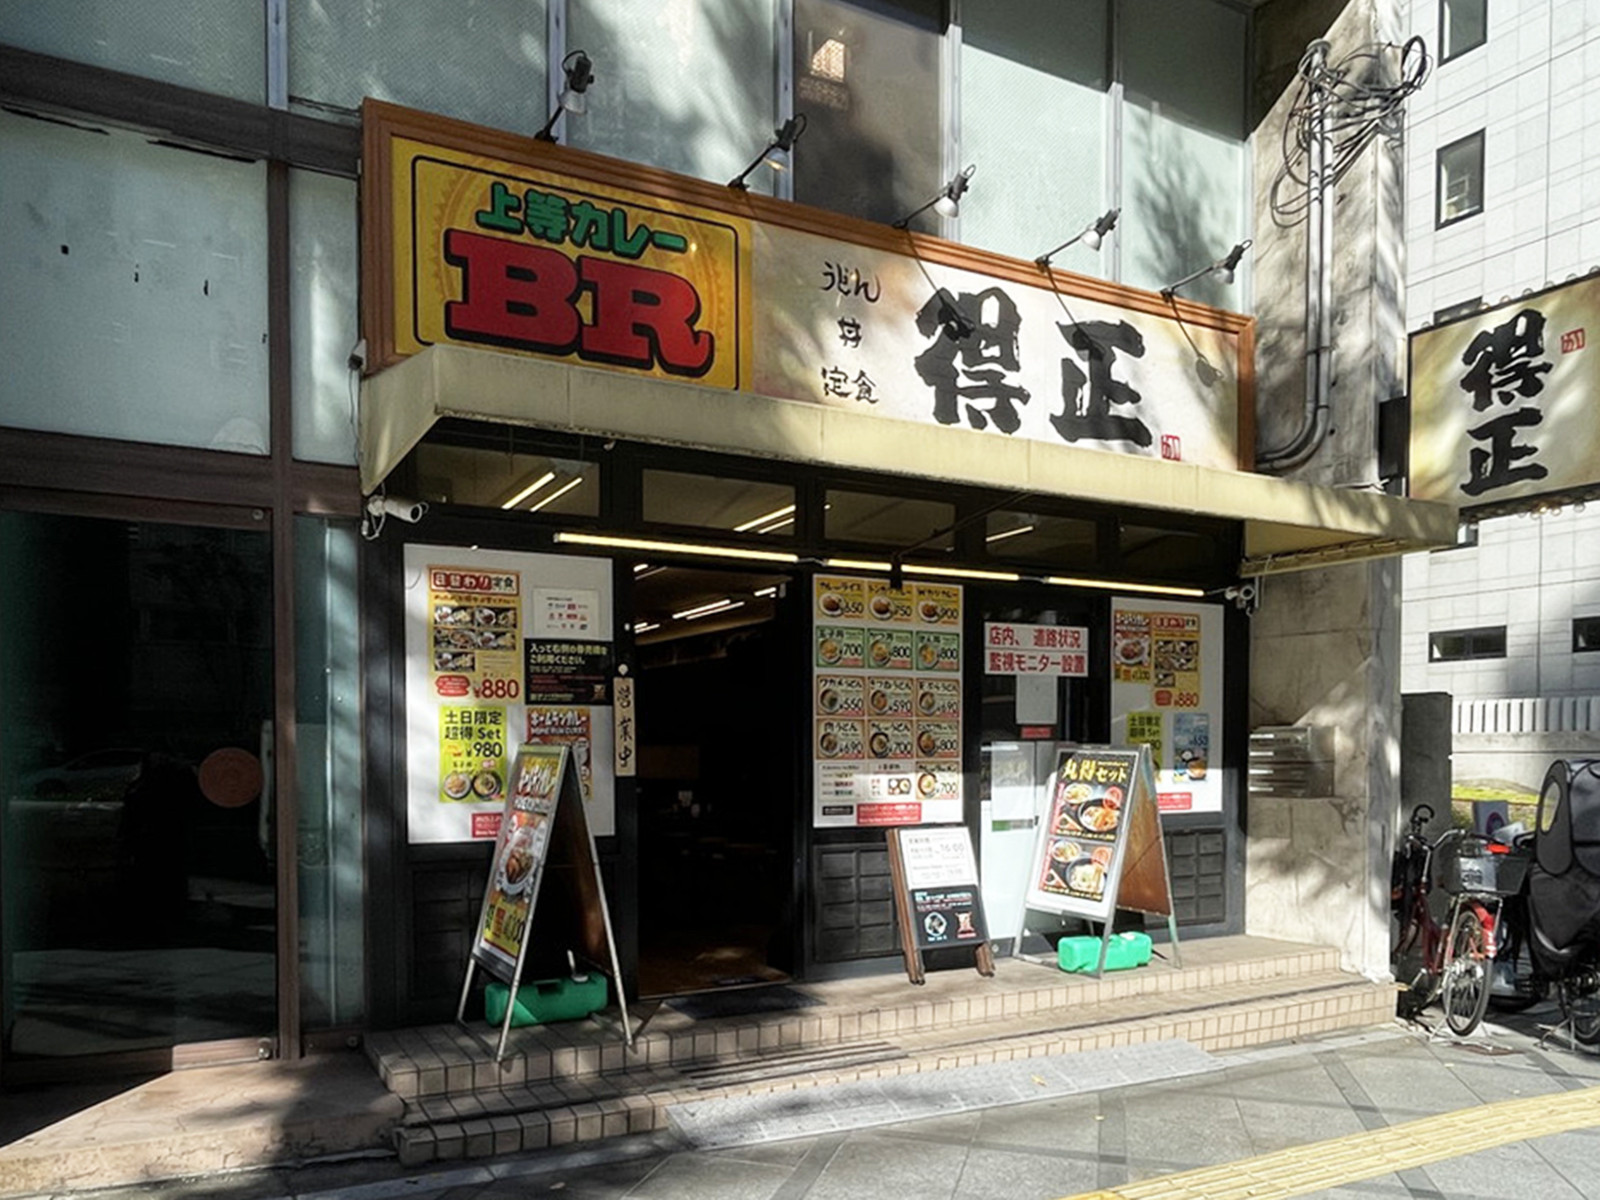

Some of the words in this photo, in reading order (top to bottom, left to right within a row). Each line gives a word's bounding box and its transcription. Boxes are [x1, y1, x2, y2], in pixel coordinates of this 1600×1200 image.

[475, 182, 688, 258] 上等カレー
[820, 262, 882, 303] うどん
[444, 227, 715, 378] BR
[837, 316, 863, 349] 丼
[820, 366, 880, 405] 定食
[914, 286, 1154, 449] 得正
[1459, 307, 1554, 497] 得正
[989, 652, 1085, 673] 監視モニター設置
[474, 678, 519, 699] ¥880
[445, 710, 502, 725] 土日限定
[477, 727, 501, 739] Set
[466, 741, 503, 758] ¥980
